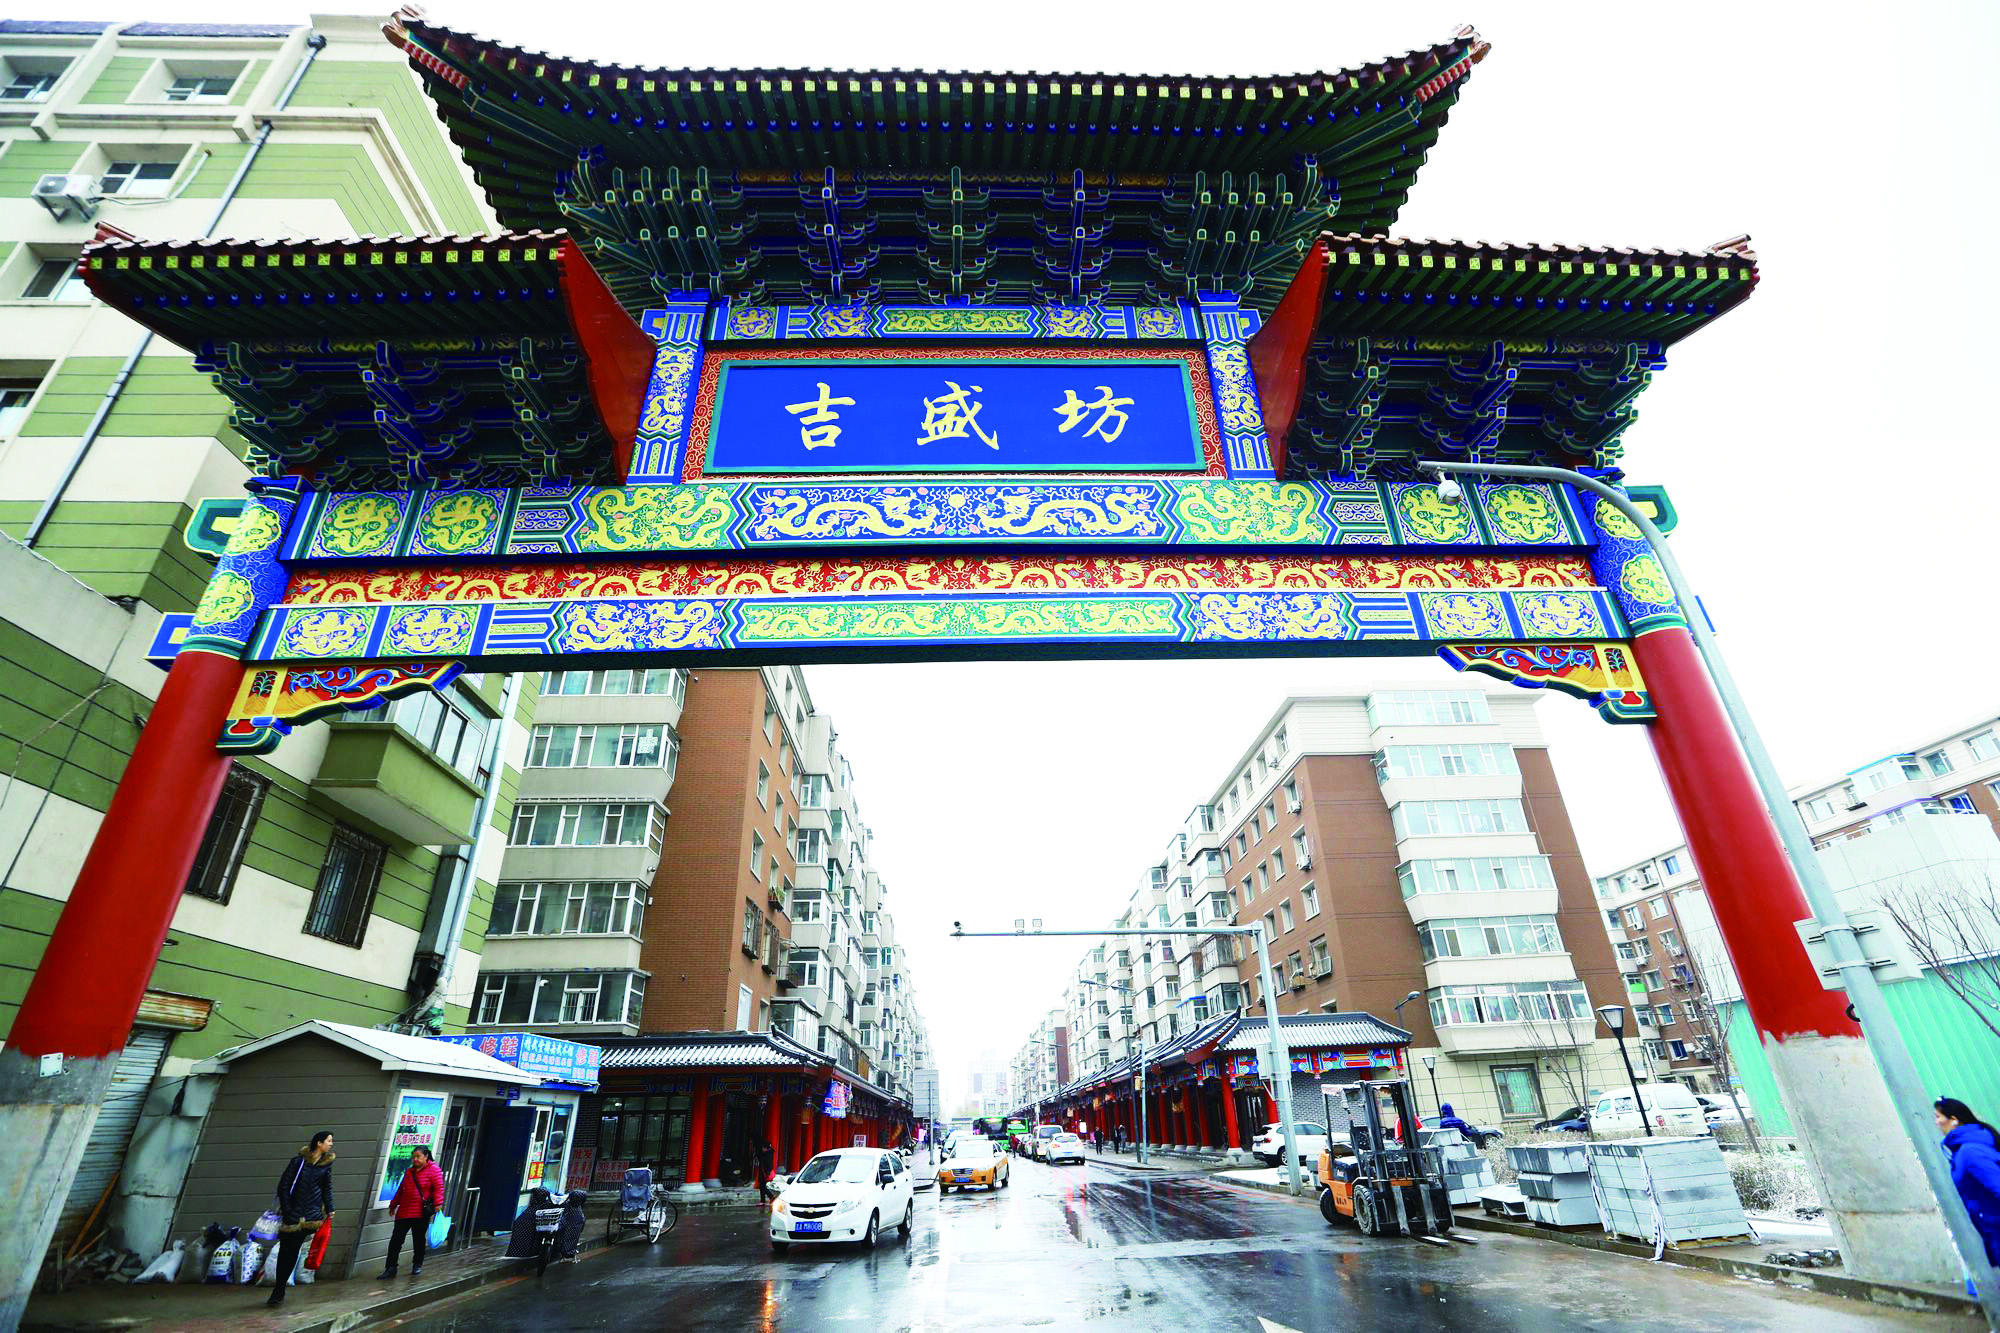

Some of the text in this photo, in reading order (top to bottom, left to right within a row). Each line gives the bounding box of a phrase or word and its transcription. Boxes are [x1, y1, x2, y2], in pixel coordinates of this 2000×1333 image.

[785, 381, 1135, 451] 吉盛坊
[480, 1036, 518, 1057] 修鞋
